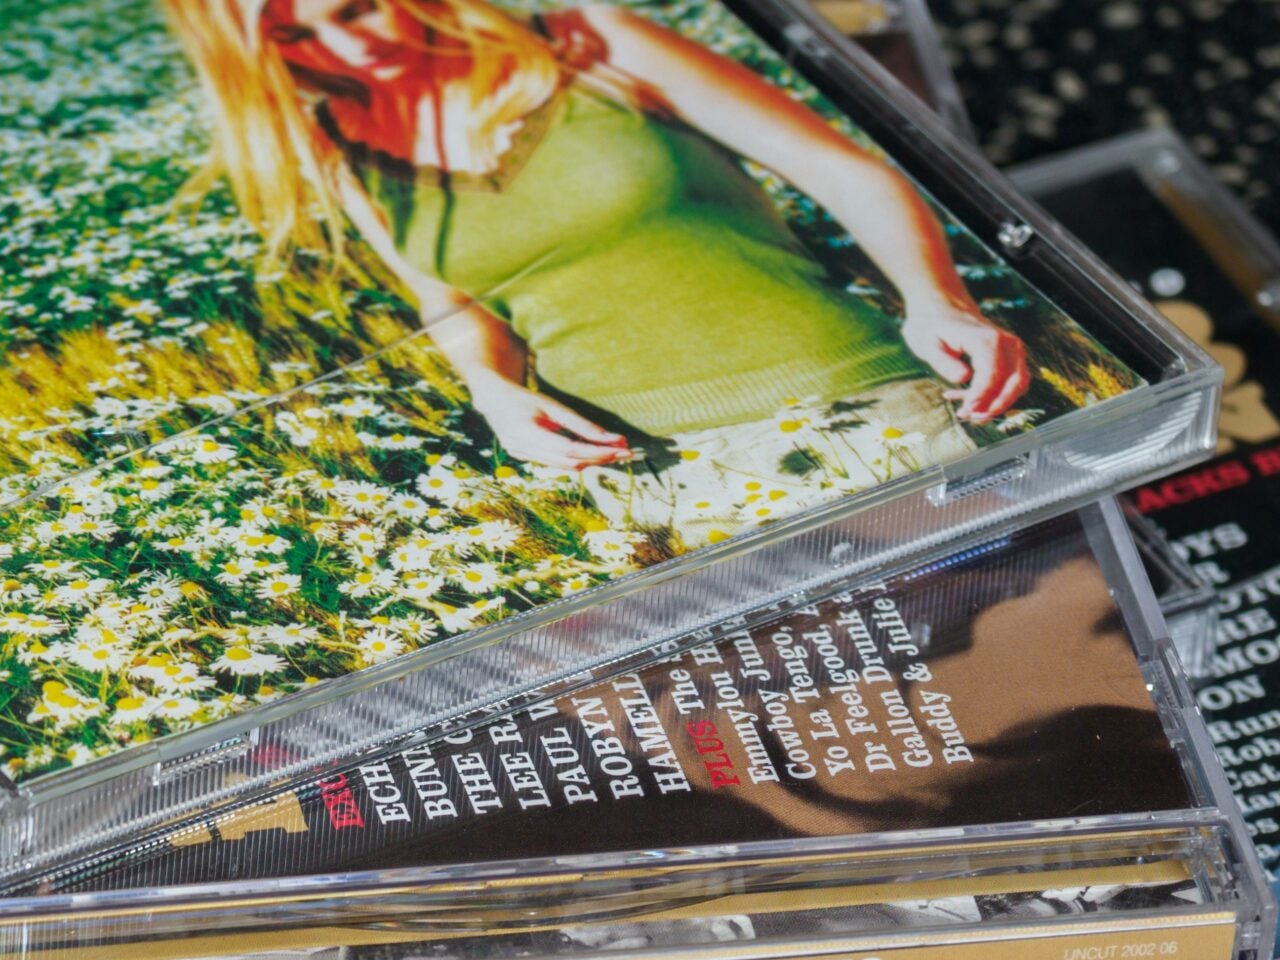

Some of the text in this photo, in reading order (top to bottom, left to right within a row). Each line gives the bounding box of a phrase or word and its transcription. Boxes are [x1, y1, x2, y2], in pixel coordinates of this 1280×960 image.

[836, 608, 893, 684] Drunk
[871, 597, 919, 657] Julie
[771, 625, 856, 777] Yo La Tengo,
[802, 623, 878, 736] Feelgood,
[902, 662, 933, 682] &
[571, 696, 645, 800] ROBYN
[612, 671, 692, 795] HAMELL
[669, 668, 741, 790] PLUS The
[710, 670, 780, 785] Emmylou
[758, 688, 817, 780] Cowboy
[864, 741, 897, 773] Dr
[880, 688, 934, 768] Gallon
[919, 689, 975, 764] Buddy
[452, 752, 503, 815] THE
[500, 752, 551, 810] LEE
[539, 727, 599, 805] PAUL
[1121, 943, 1156, 959] 2002
[1159, 940, 1179, 956] 06
